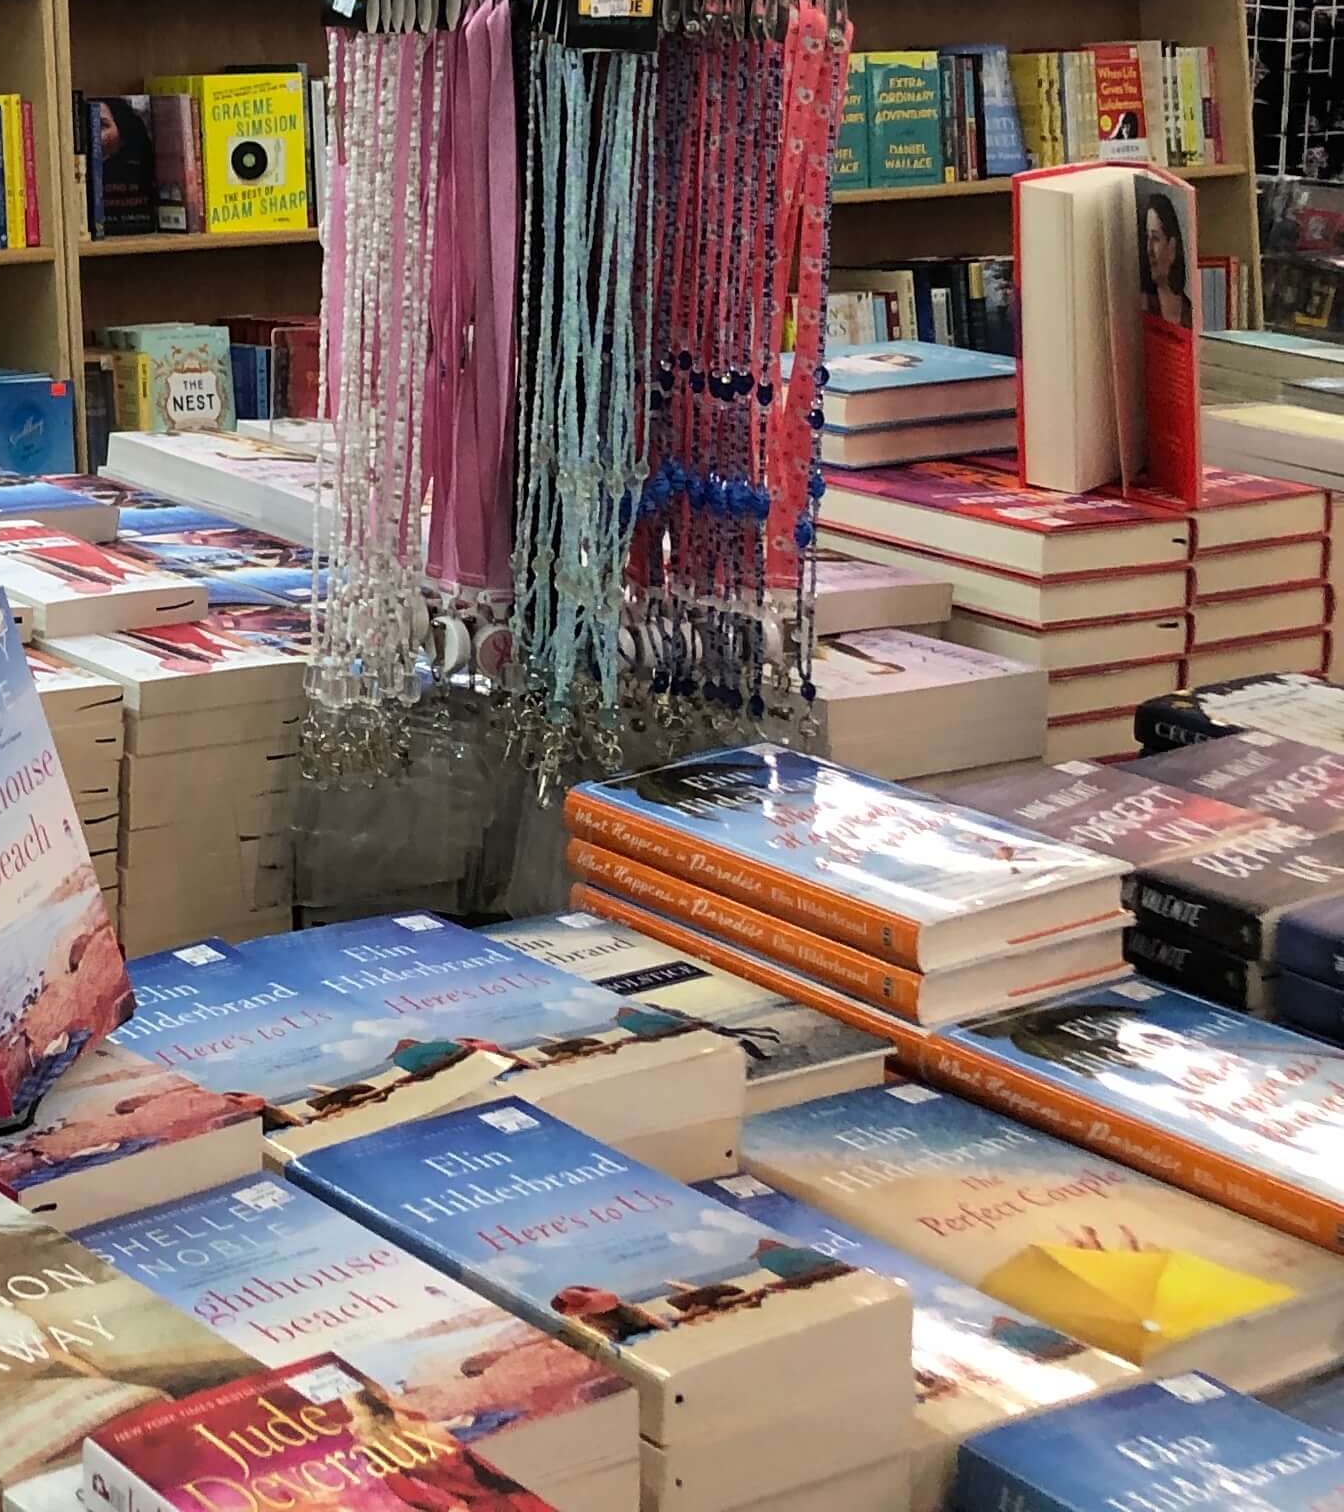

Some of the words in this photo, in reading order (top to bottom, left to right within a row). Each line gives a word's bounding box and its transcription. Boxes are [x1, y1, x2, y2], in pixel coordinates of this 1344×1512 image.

[213, 97, 273, 121] GRAEME
[236, 114, 296, 137] SIMSION
[212, 205, 253, 224] ADAM
[260, 191, 306, 215] SHARP
[173, 393, 215, 412] NEST
[835, 1124, 918, 1152] Elin
[422, 1148, 512, 1179] Elin
[403, 1153, 629, 1225] Hilderbrand
[474, 1211, 583, 1254] Here's
[590, 1204, 622, 1224] to
[619, 1191, 675, 1218] Us
[915, 1187, 1018, 1237] Perfect
